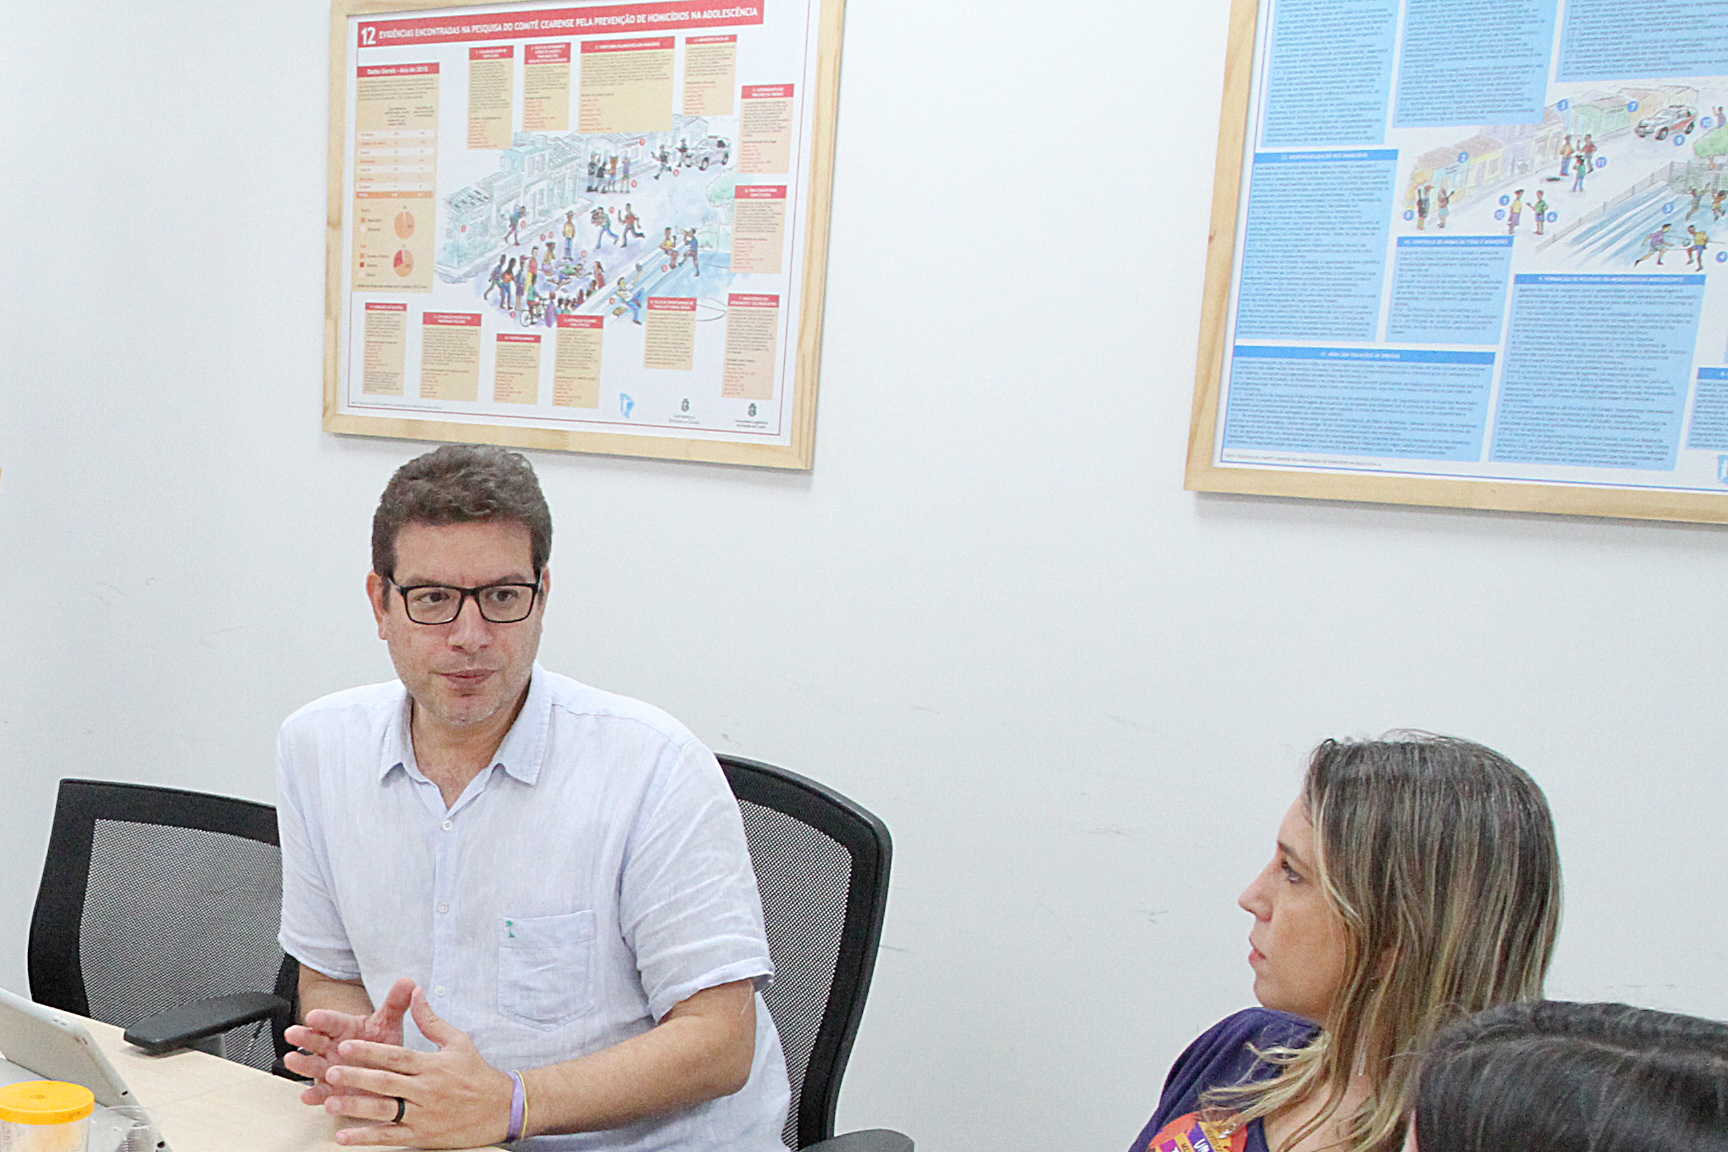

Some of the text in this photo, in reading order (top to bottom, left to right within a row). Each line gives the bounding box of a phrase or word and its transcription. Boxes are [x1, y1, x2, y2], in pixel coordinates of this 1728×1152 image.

[360, 26, 376, 45] 12
[379, 28, 415, 39] EVIDÊNCIAS
[416, 26, 461, 37] ENCONTRADAS
[462, 26, 471, 34] NA
[472, 24, 502, 34] PESQUISA
[514, 20, 539, 31] COMITÊ
[540, 18, 574, 29] CEARENSE
[576, 18, 593, 27] PELA
[594, 14, 635, 26] PREVENÇÃO
[636, 14, 647, 23] DE
[648, 11, 690, 22] HOMICÍDIOS
[692, 10, 702, 19] NA
[702, 7, 758, 19] ADOLESCÊNCIA
